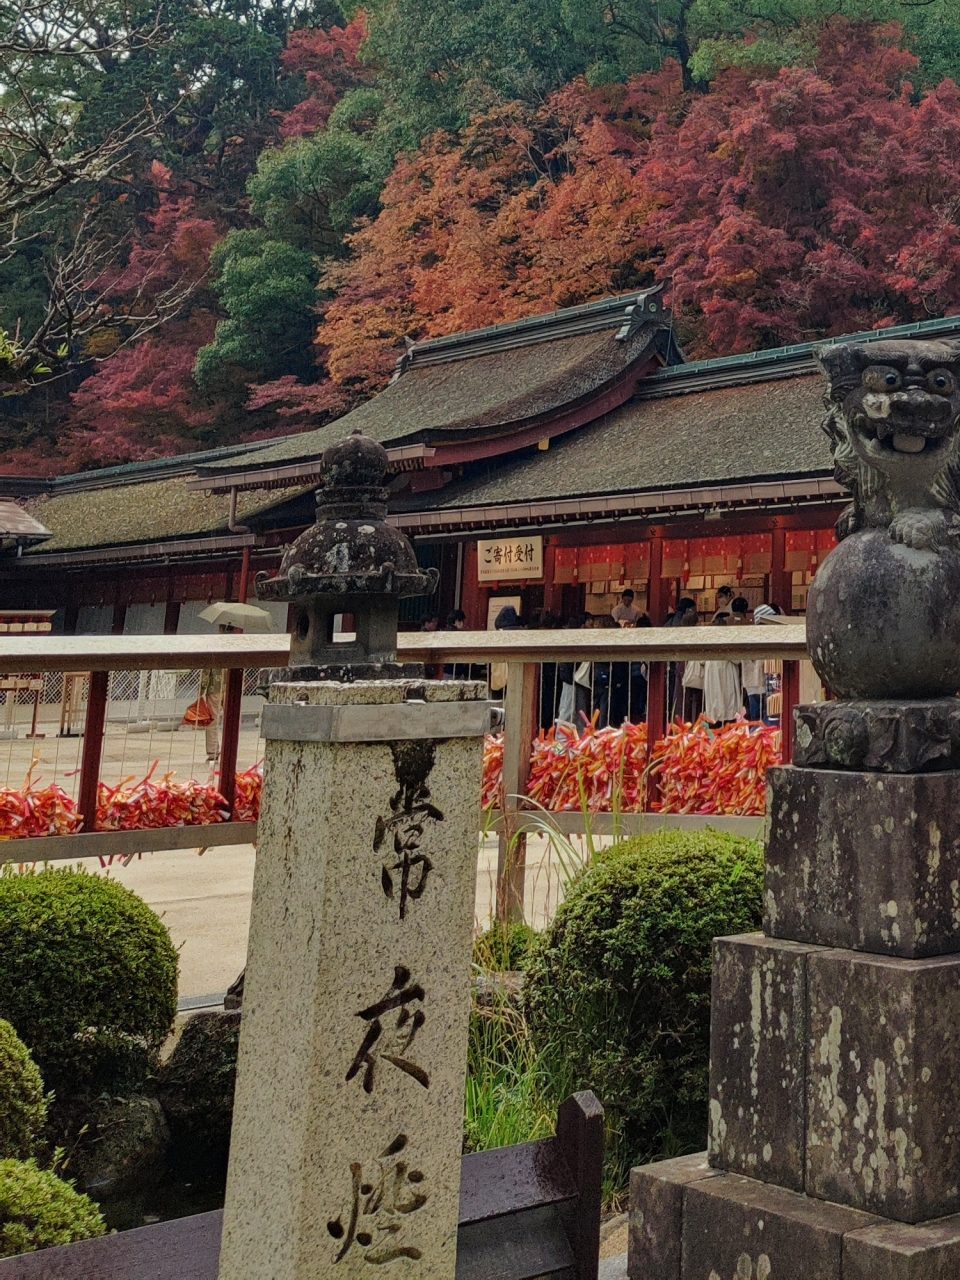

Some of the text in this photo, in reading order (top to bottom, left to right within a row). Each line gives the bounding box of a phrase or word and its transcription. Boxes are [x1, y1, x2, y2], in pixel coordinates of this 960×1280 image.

[484, 543, 534, 565] ご寄付受付
